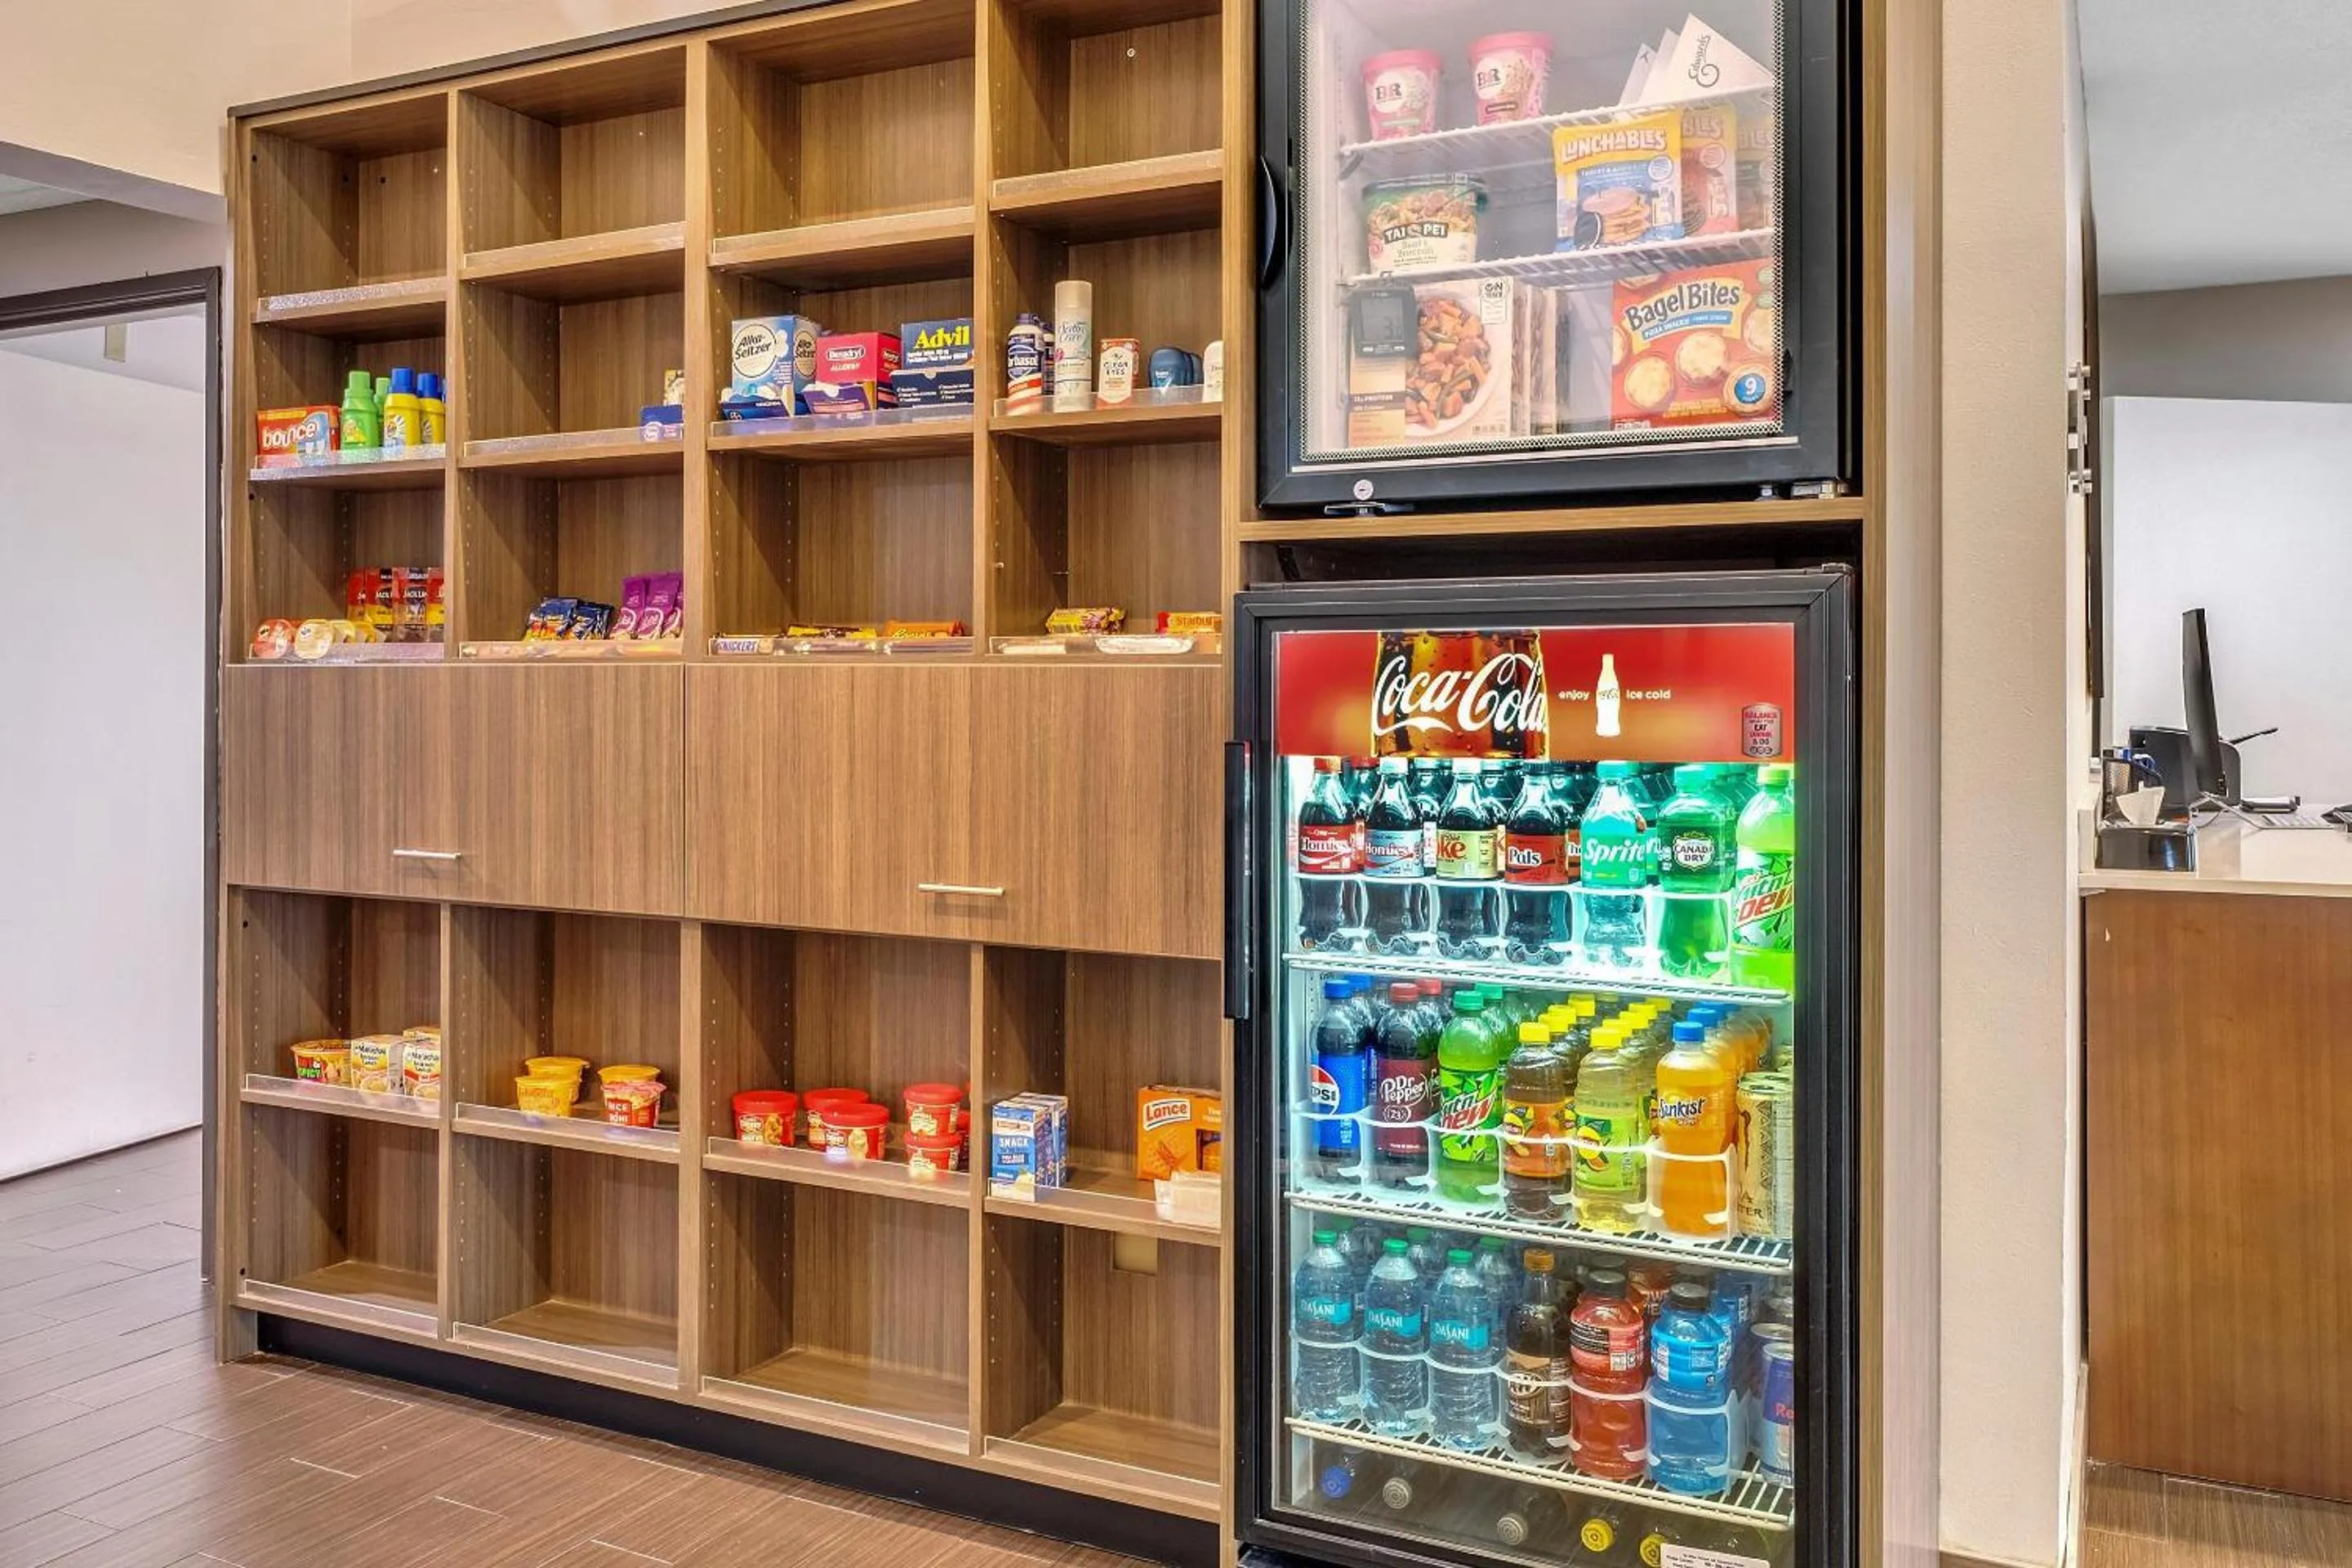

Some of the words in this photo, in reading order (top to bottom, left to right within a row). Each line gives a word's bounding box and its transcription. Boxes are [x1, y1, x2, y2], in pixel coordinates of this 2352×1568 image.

[1560, 128, 1668, 163] LUNCHABLES
[1385, 226, 1405, 242] TAI
[1423, 224, 1446, 238] PEI
[1624, 285, 1685, 331] Bagel
[1686, 281, 1741, 310] Bites
[913, 325, 969, 350] Advil
[735, 341, 773, 359] Seltzer
[1744, 377, 1757, 395] 9
[262, 421, 316, 450] bounce
[1372, 653, 1548, 736] Coca-Cola
[1558, 689, 1589, 702] enjoy
[1626, 689, 1643, 700] ice
[1646, 689, 1671, 700] cold
[1754, 724, 1767, 732] EAT
[1508, 846, 1543, 866] Pals
[1584, 838, 1646, 866] Sprite
[1684, 854, 1706, 862] DRY
[1380, 1078, 1424, 1103] Pepper
[1396, 1076, 1415, 1089] Dr
[1146, 1102, 1187, 1121] Lance
[1659, 1098, 1704, 1119] Sunkist
[999, 1138, 1028, 1147] SNACK
[1300, 1298, 1335, 1316] DASANI
[1368, 1310, 1404, 1328] DASANI
[1434, 1322, 1470, 1340] DASANI
[1775, 1402, 1794, 1419] Re
